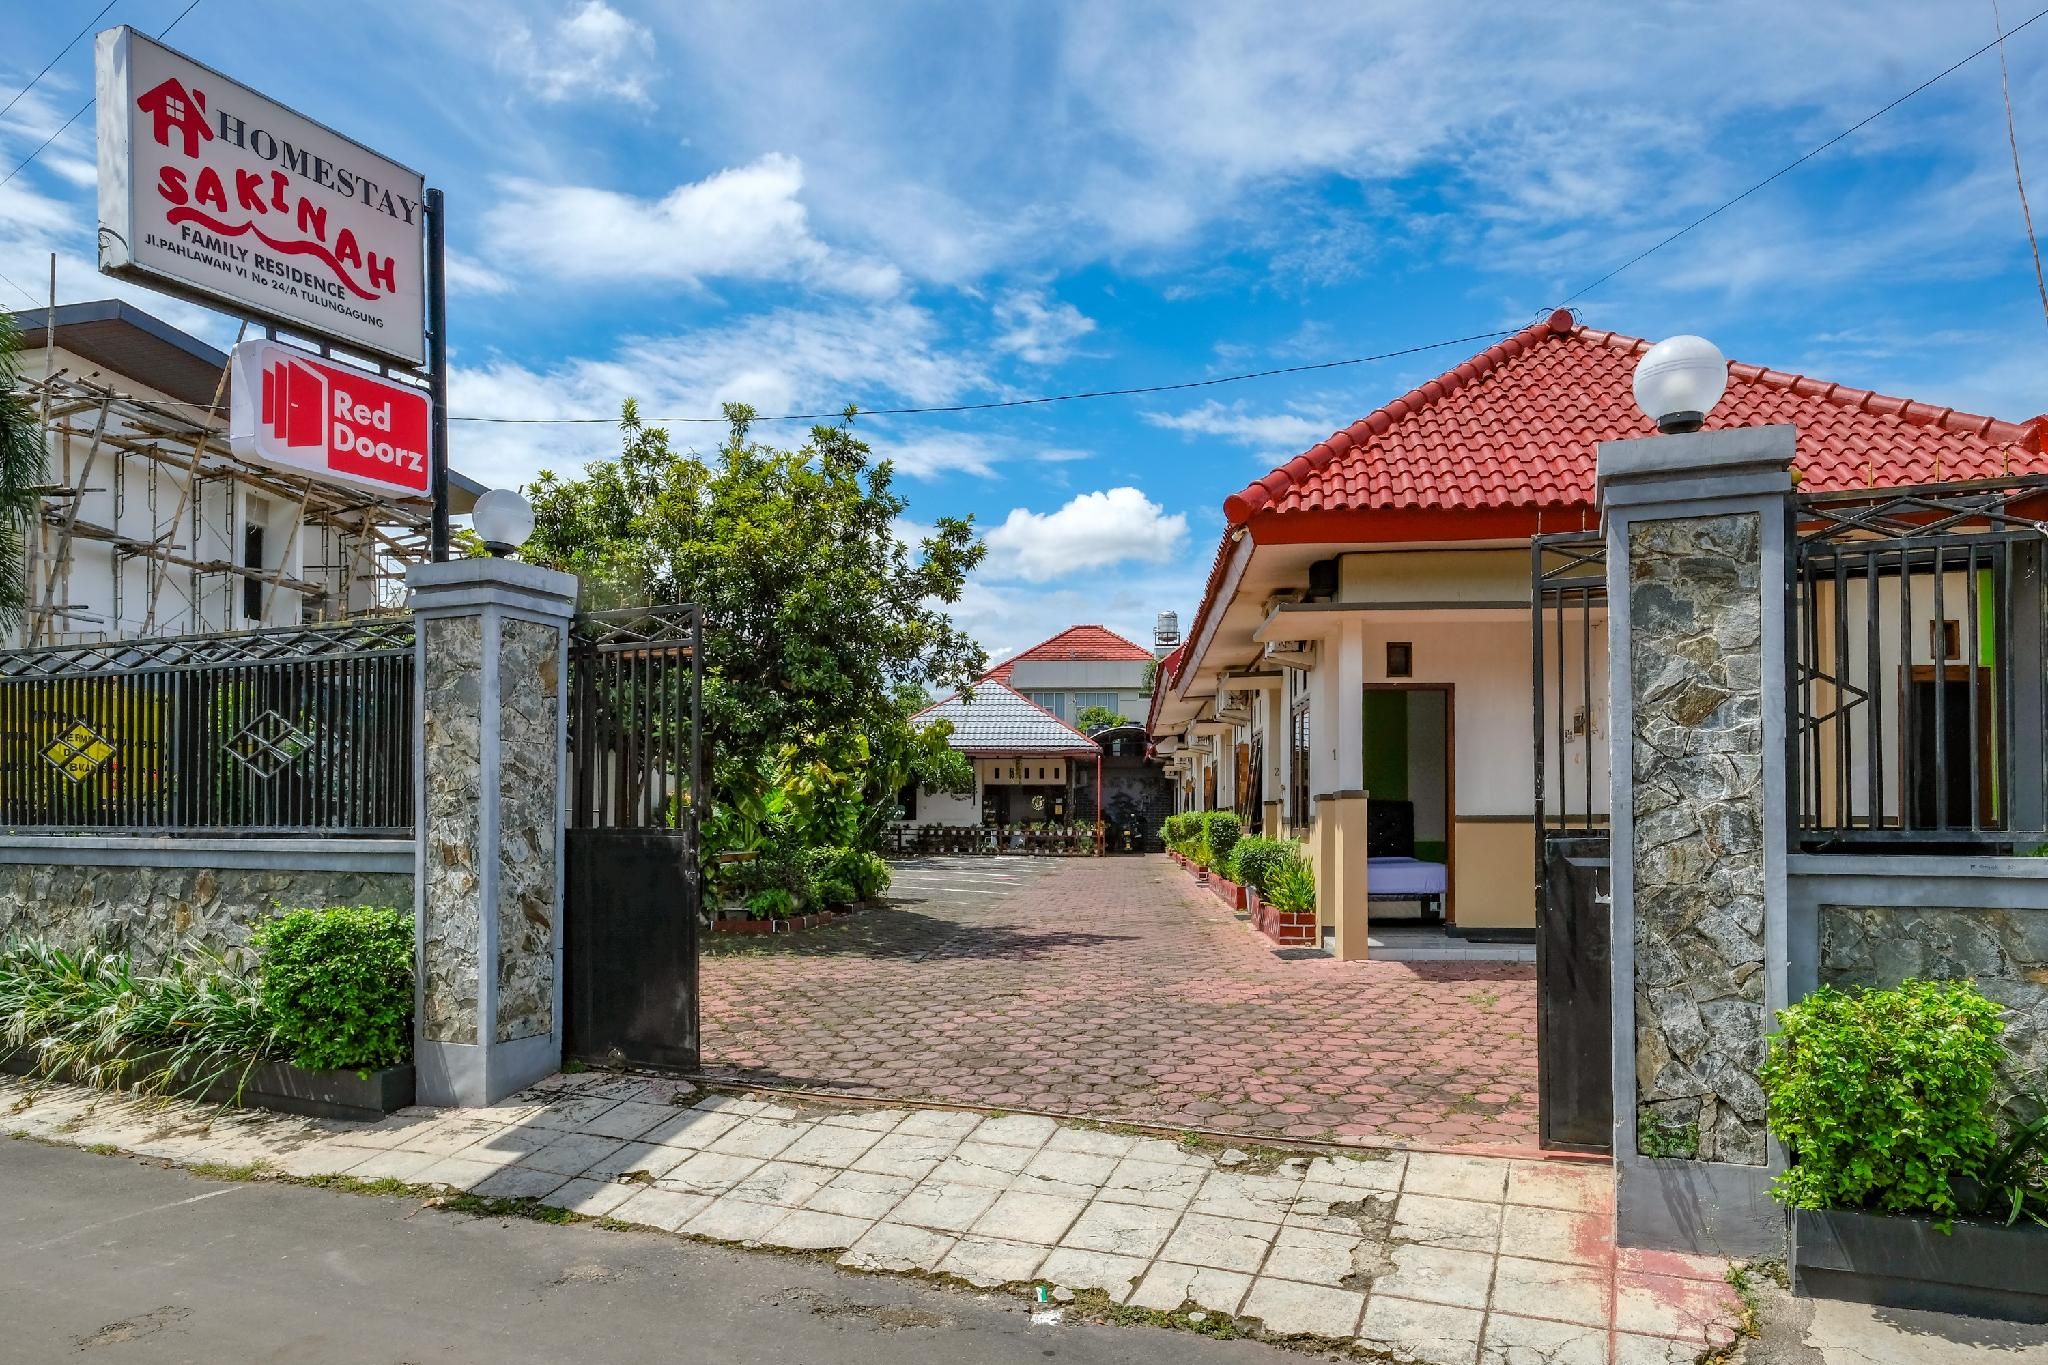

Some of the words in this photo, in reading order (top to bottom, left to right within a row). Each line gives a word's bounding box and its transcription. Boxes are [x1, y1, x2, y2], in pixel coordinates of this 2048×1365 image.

[216, 109, 419, 226] HOMESTAY
[157, 166, 396, 293] SAKINAH
[181, 225, 248, 262] FAMILY
[254, 253, 346, 300] RESIDENCE
[235, 265, 247, 278] VI
[251, 271, 268, 286] No
[271, 280, 298, 297] 24/A
[300, 289, 384, 328] TULUNGAGUNG
[334, 389, 391, 432] Red
[333, 422, 423, 473] Doorz
